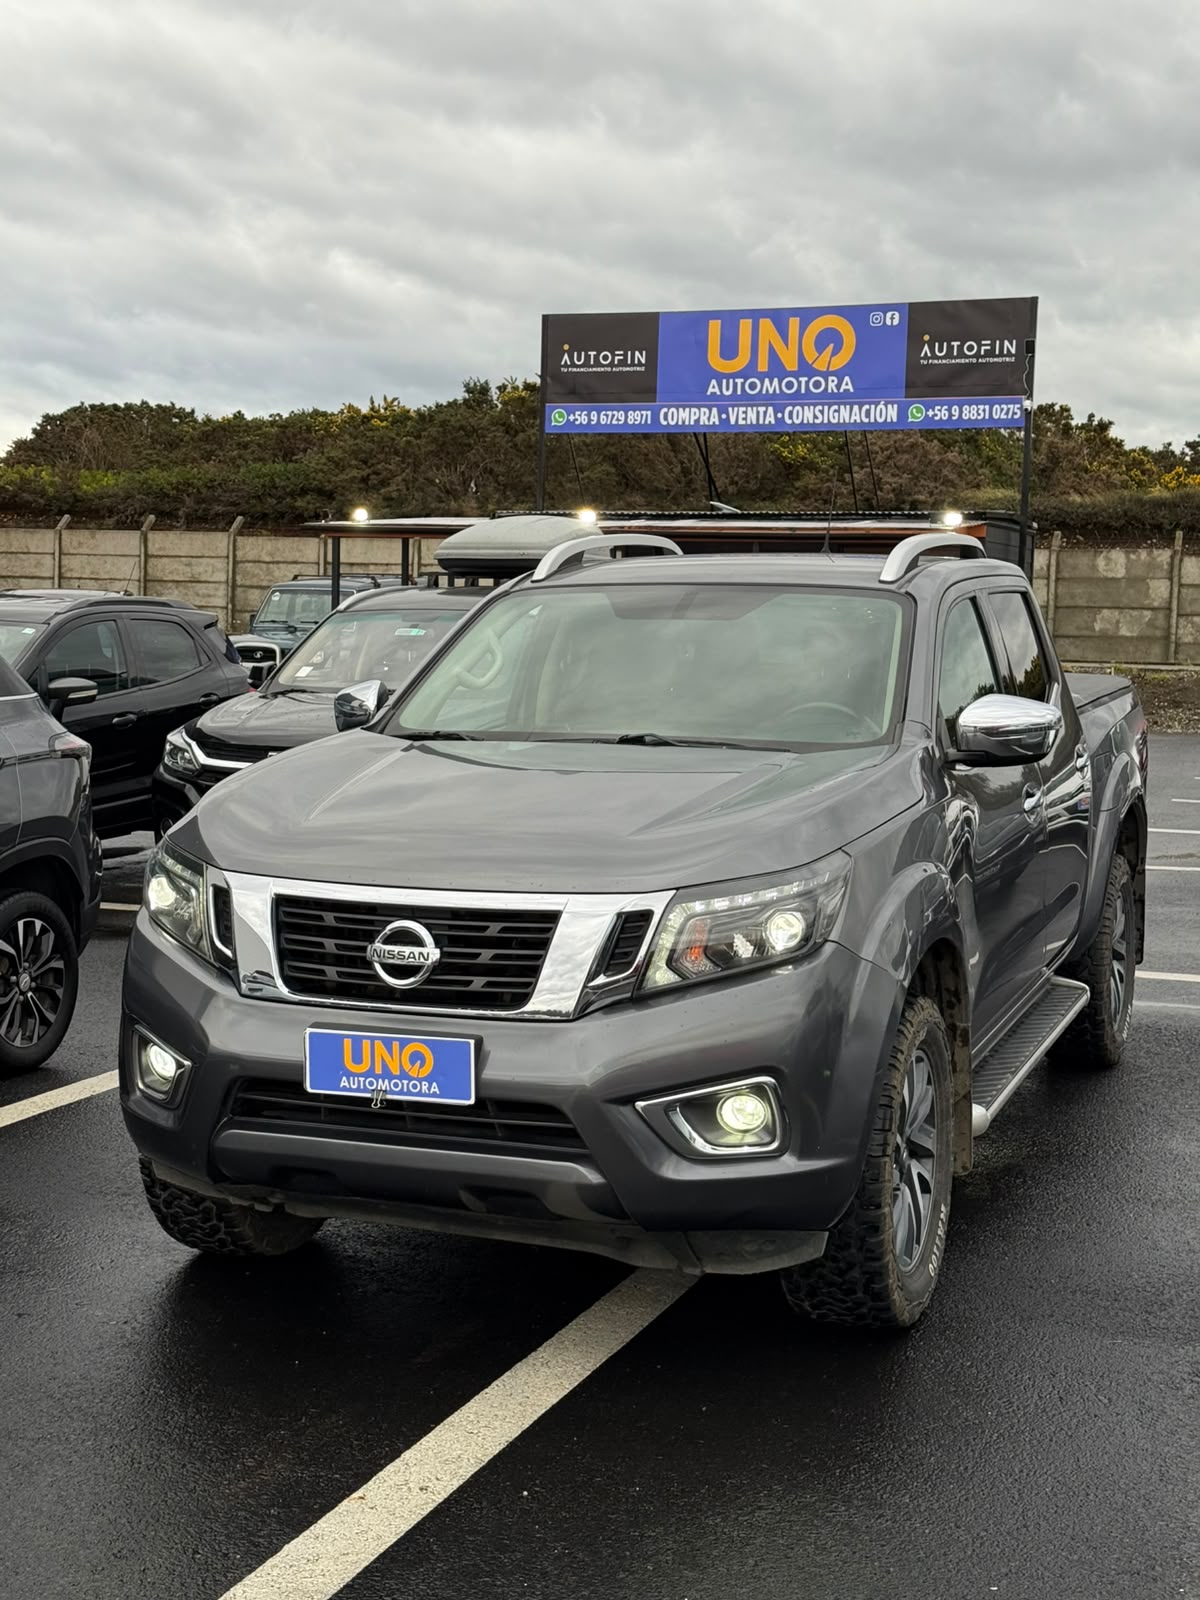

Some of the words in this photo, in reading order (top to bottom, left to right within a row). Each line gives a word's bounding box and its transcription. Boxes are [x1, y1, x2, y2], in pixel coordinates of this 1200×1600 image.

[707, 314, 857, 374] UNO
[920, 339, 1016, 357] AUTOFIN
[560, 350, 647, 366] AUTOFIN
[706, 376, 854, 396] AUTOMOTORA
[568, 410, 589, 425] +56
[590, 410, 598, 425] 9
[599, 410, 626, 425] 6729
[627, 410, 652, 425] 8971
[926, 405, 949, 420] +56
[951, 405, 960, 420] 9
[962, 404, 990, 420] 8831
[992, 404, 1022, 420] 0275
[372, 947, 430, 962] NISSAN
[343, 1037, 434, 1079] UNO
[340, 1076, 440, 1094] AUTOMOTORA
